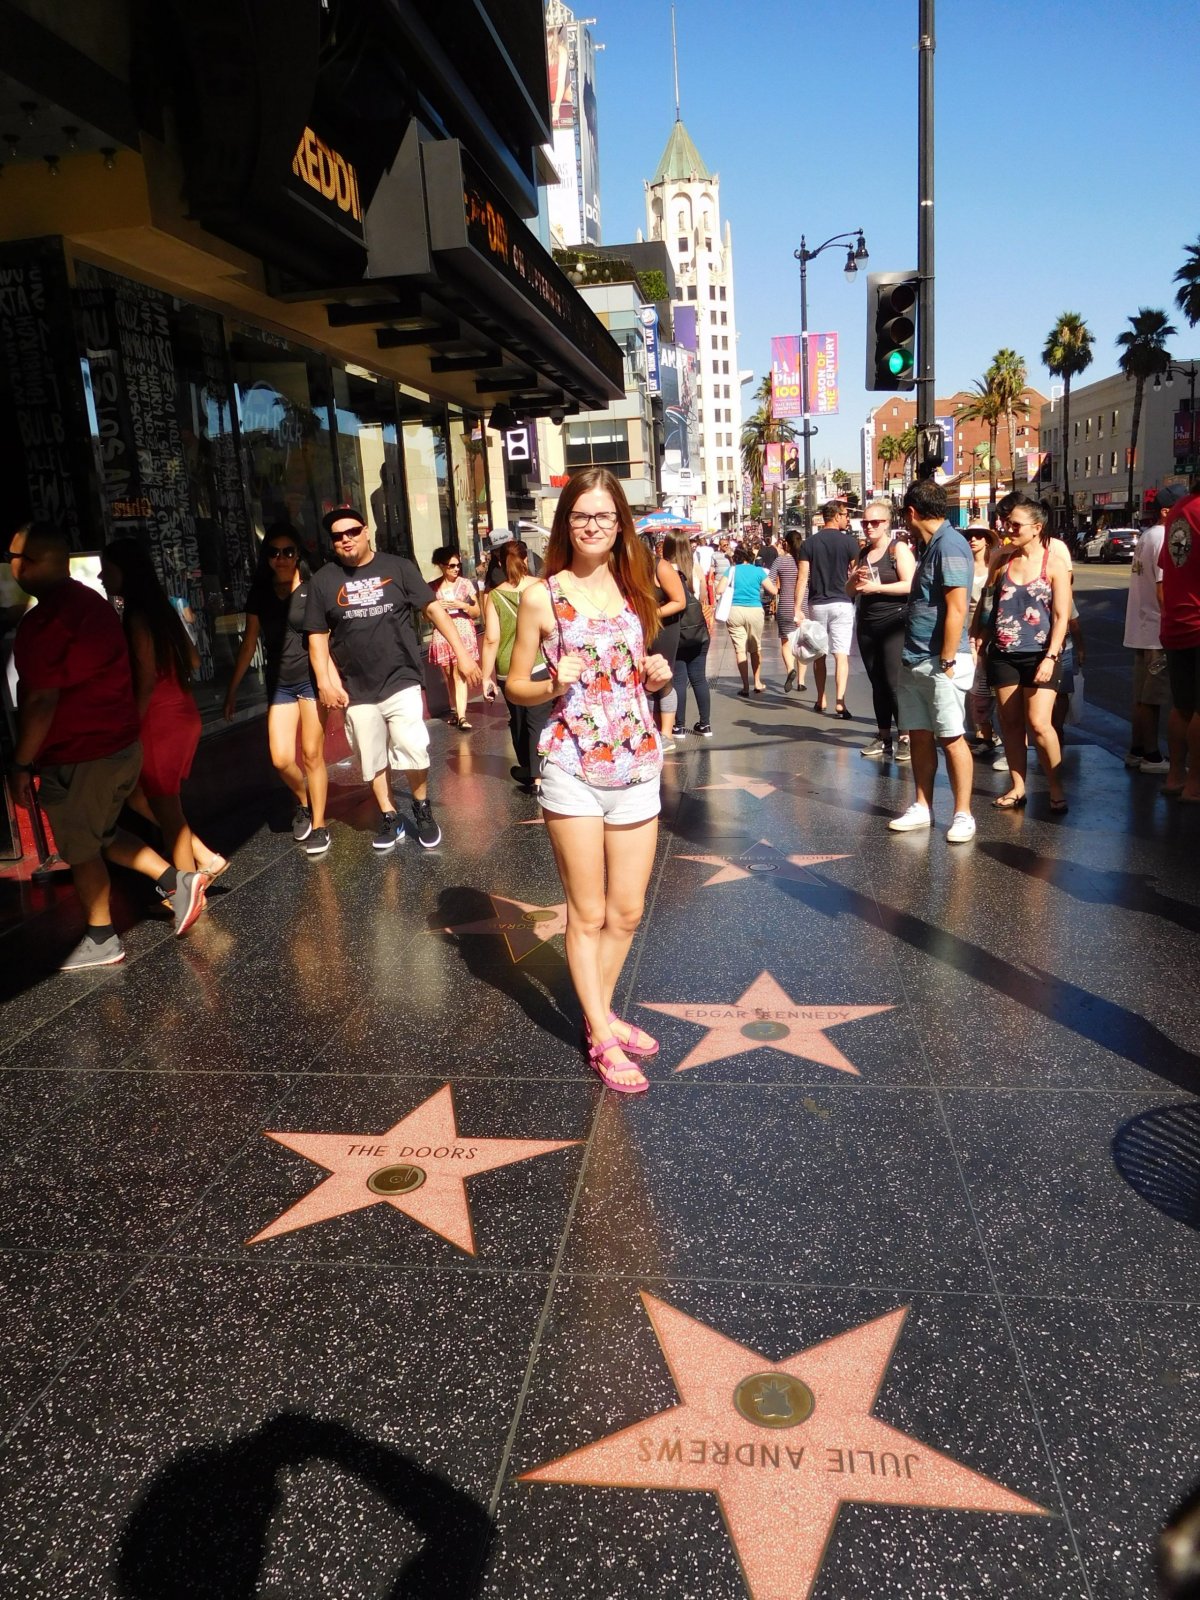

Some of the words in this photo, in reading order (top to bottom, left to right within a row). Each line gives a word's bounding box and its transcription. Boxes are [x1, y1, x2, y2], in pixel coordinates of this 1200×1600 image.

[773, 360, 790, 373] LA
[817, 352, 826, 367] OF
[825, 336, 835, 387] CENTURY
[774, 371, 800, 386] Phil
[775, 385, 800, 398] 100
[817, 370, 827, 411] SEASON
[827, 389, 836, 412] THE
[342, 608, 368, 620] JUST
[368, 605, 384, 617] DO
[685, 1009, 750, 1019] EDGAR
[346, 1144, 390, 1157] THE
[399, 1146, 479, 1160] DOORS
[637, 1436, 804, 1470] ANDREWS
[826, 1447, 918, 1479] JULIE
